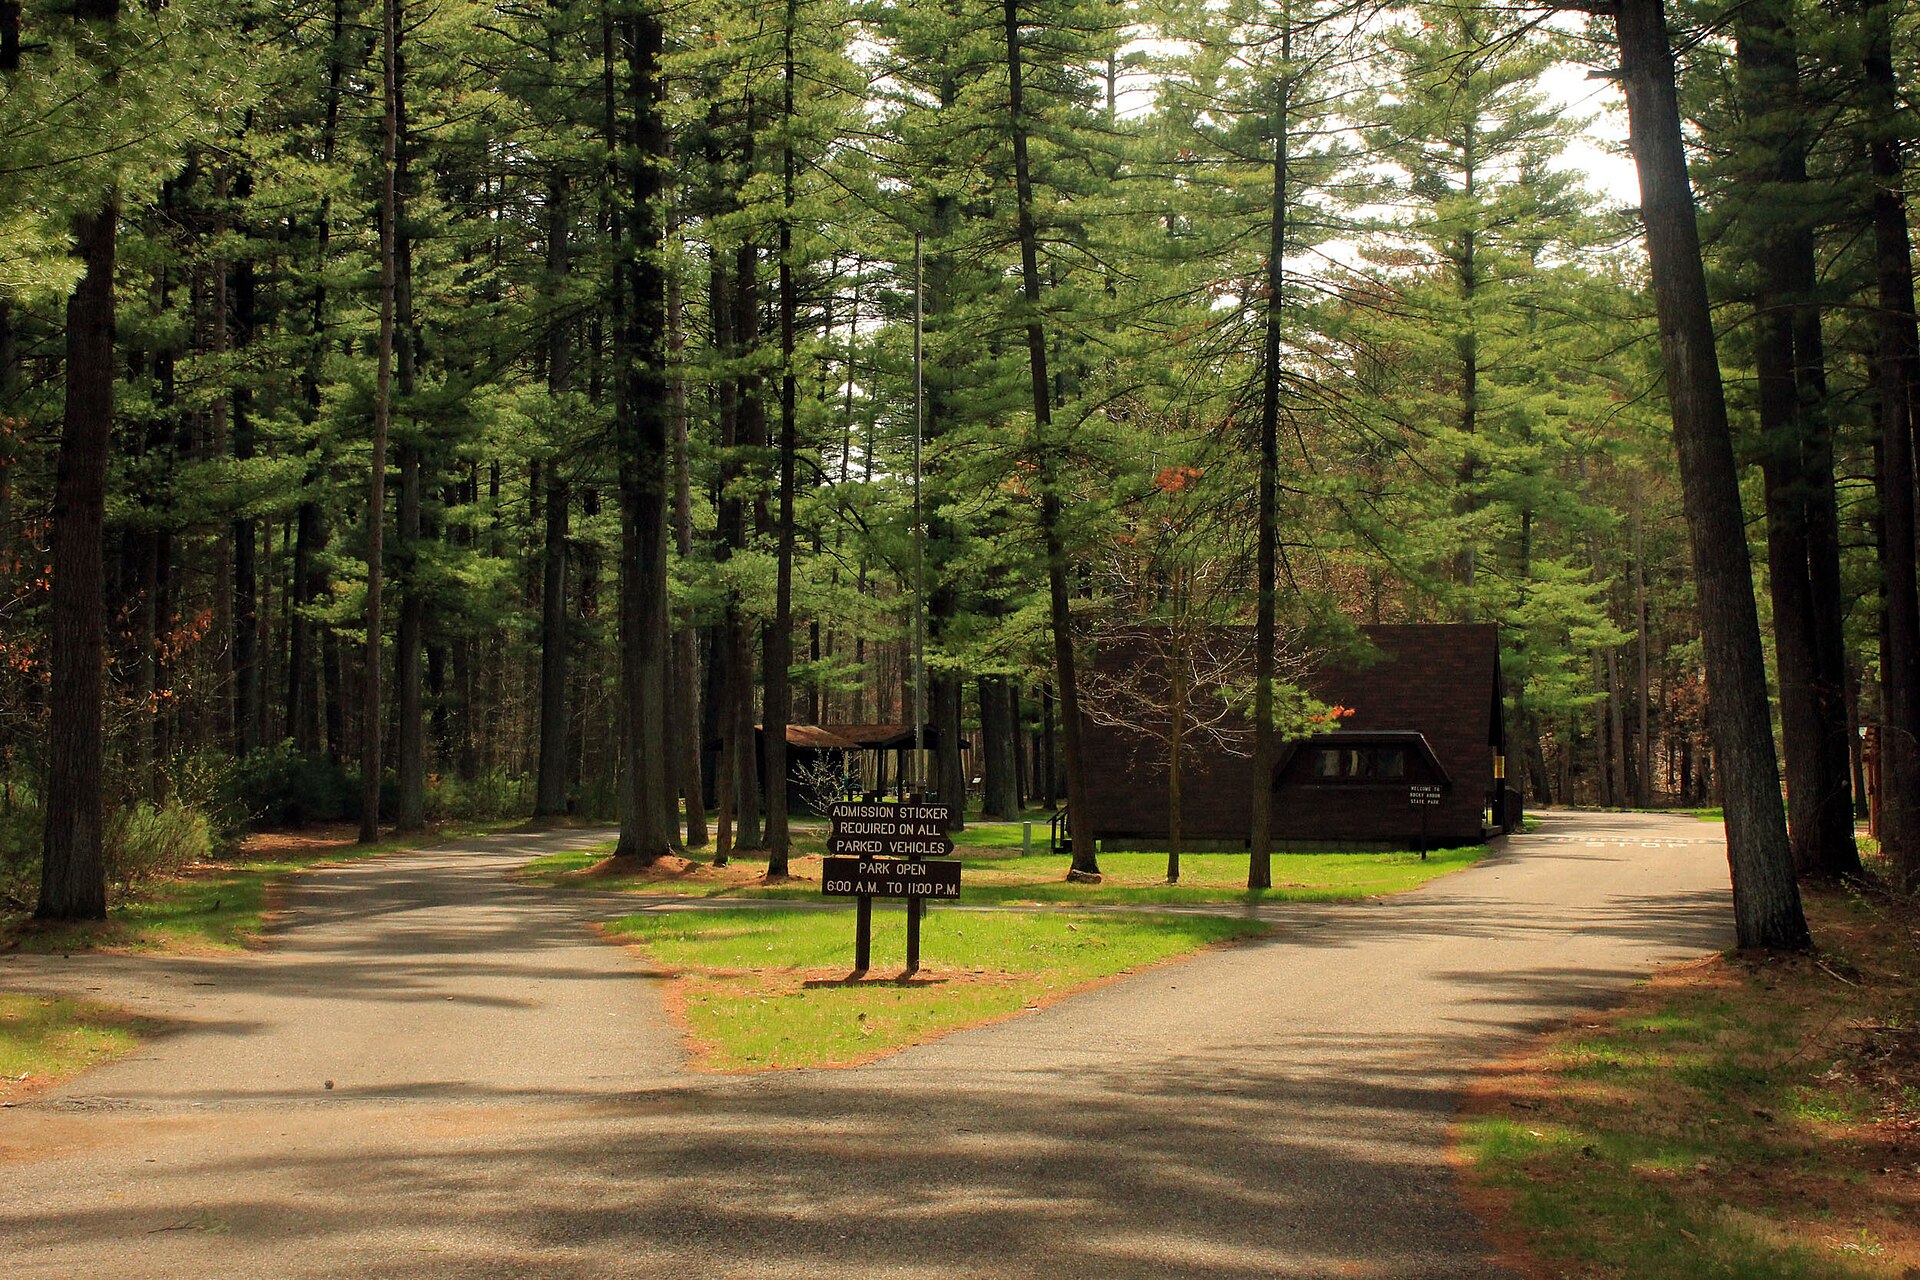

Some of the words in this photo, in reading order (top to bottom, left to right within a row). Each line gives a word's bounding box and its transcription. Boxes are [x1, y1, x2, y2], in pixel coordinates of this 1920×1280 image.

[833, 806, 894, 818] ADMISSION
[900, 807, 948, 819] STICKER
[840, 822, 896, 834] REQUIRED
[900, 824, 914, 835] ON
[918, 825, 941, 836] ALL
[837, 841, 882, 852] PARKED
[890, 842, 945, 854] VEHICLES
[860, 863, 890, 874] PARK
[897, 864, 926, 875] OPEN
[827, 881, 851, 892] 6:00
[855, 882, 880, 893] A.M.
[887, 882, 903, 893] TO
[908, 883, 932, 894] 11:00
[936, 884, 959, 895] P.M.
